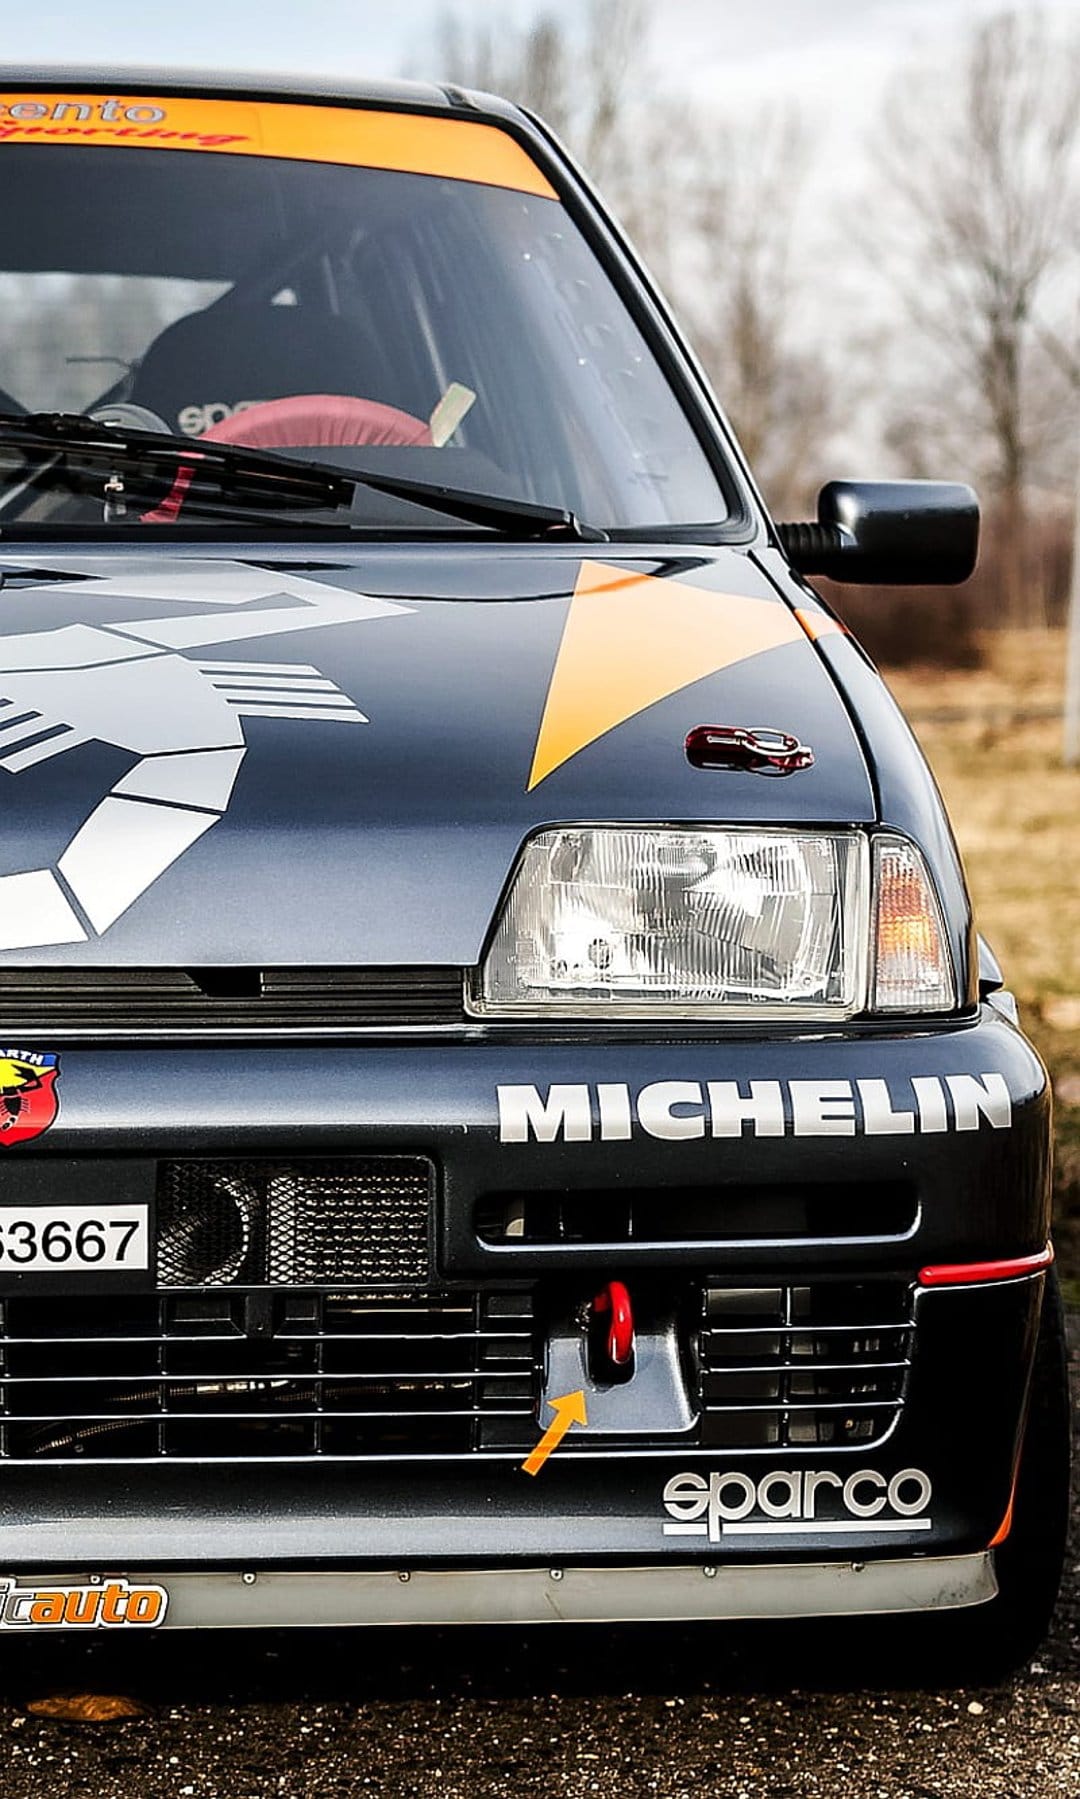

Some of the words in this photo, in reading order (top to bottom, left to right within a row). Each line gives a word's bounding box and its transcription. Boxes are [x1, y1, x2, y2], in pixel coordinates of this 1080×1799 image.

[0, 99, 164, 123] ento
[0, 121, 251, 146] porting
[497, 1073, 1012, 1143] MICHELIN
[0, 1220, 140, 1263] 3667
[663, 1468, 932, 1542] sparco
